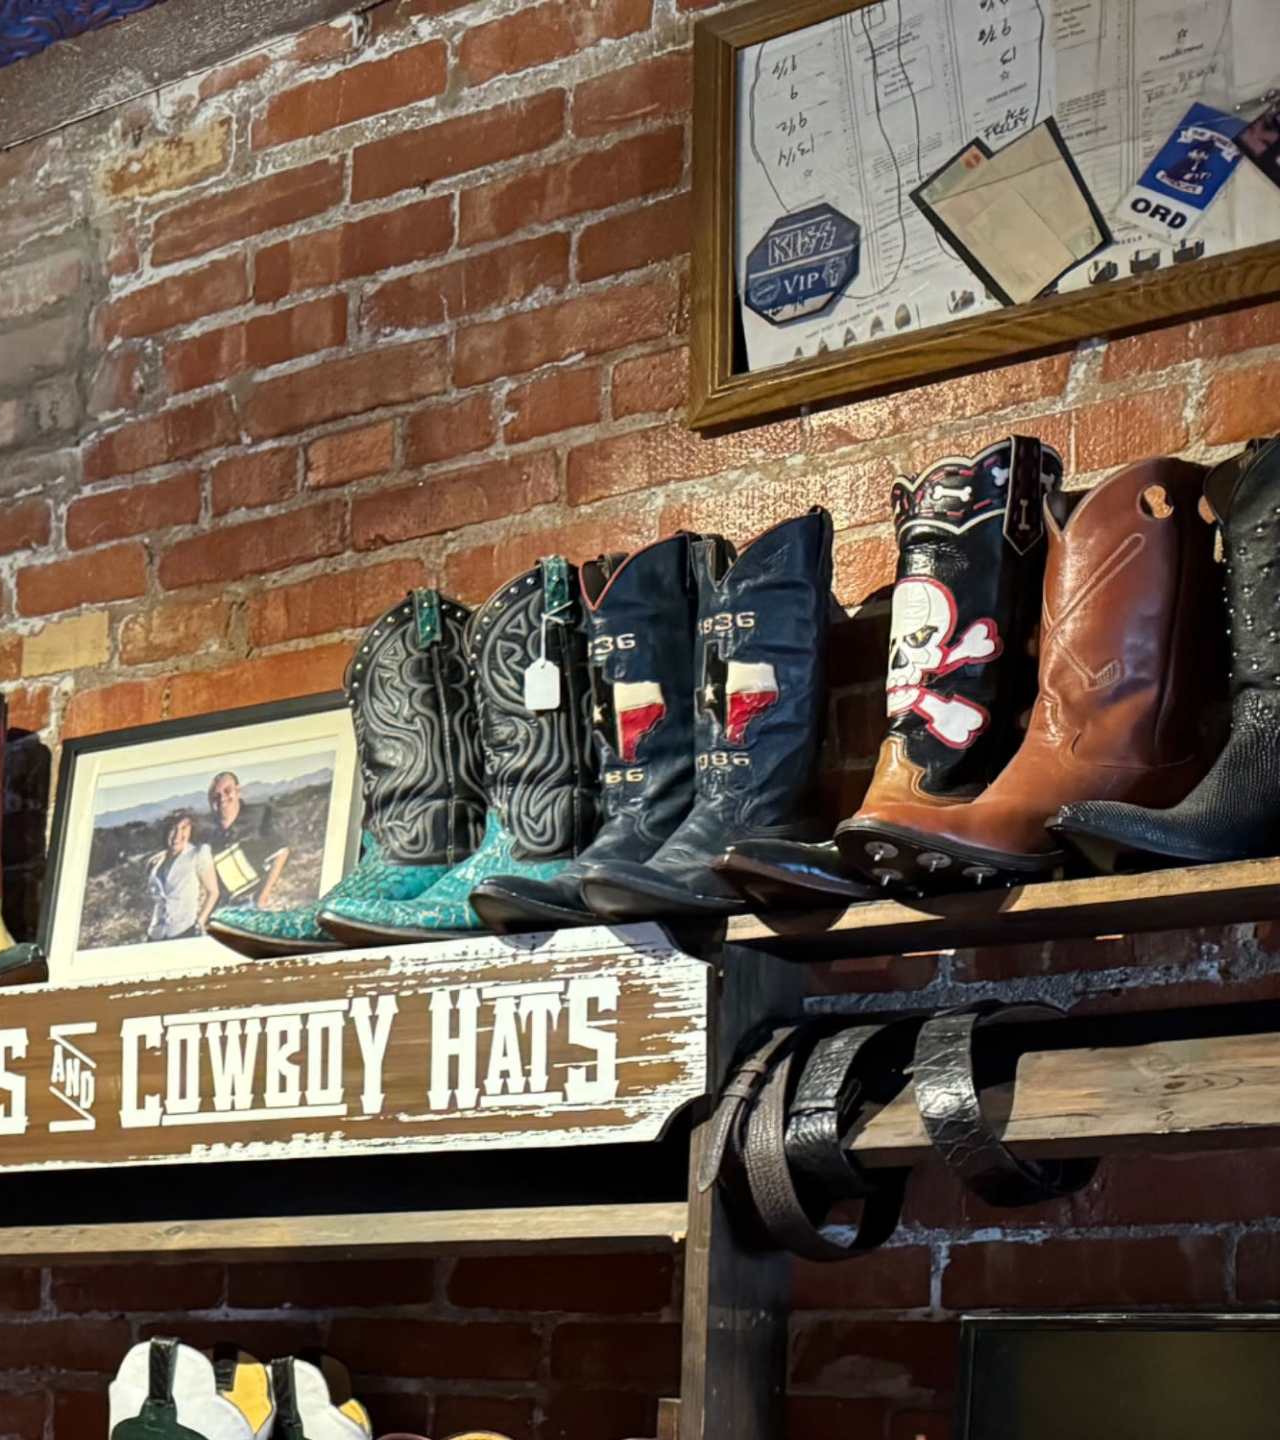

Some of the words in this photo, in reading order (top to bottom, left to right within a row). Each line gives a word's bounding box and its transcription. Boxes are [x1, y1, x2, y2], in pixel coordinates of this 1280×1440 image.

[1130, 197, 1188, 230] ORD
[767, 220, 837, 267] KISS
[783, 272, 820, 295] VIP
[50, 1056, 96, 1109] AND
[119, 995, 398, 1130] COWBOY
[427, 977, 622, 1110] HATS
